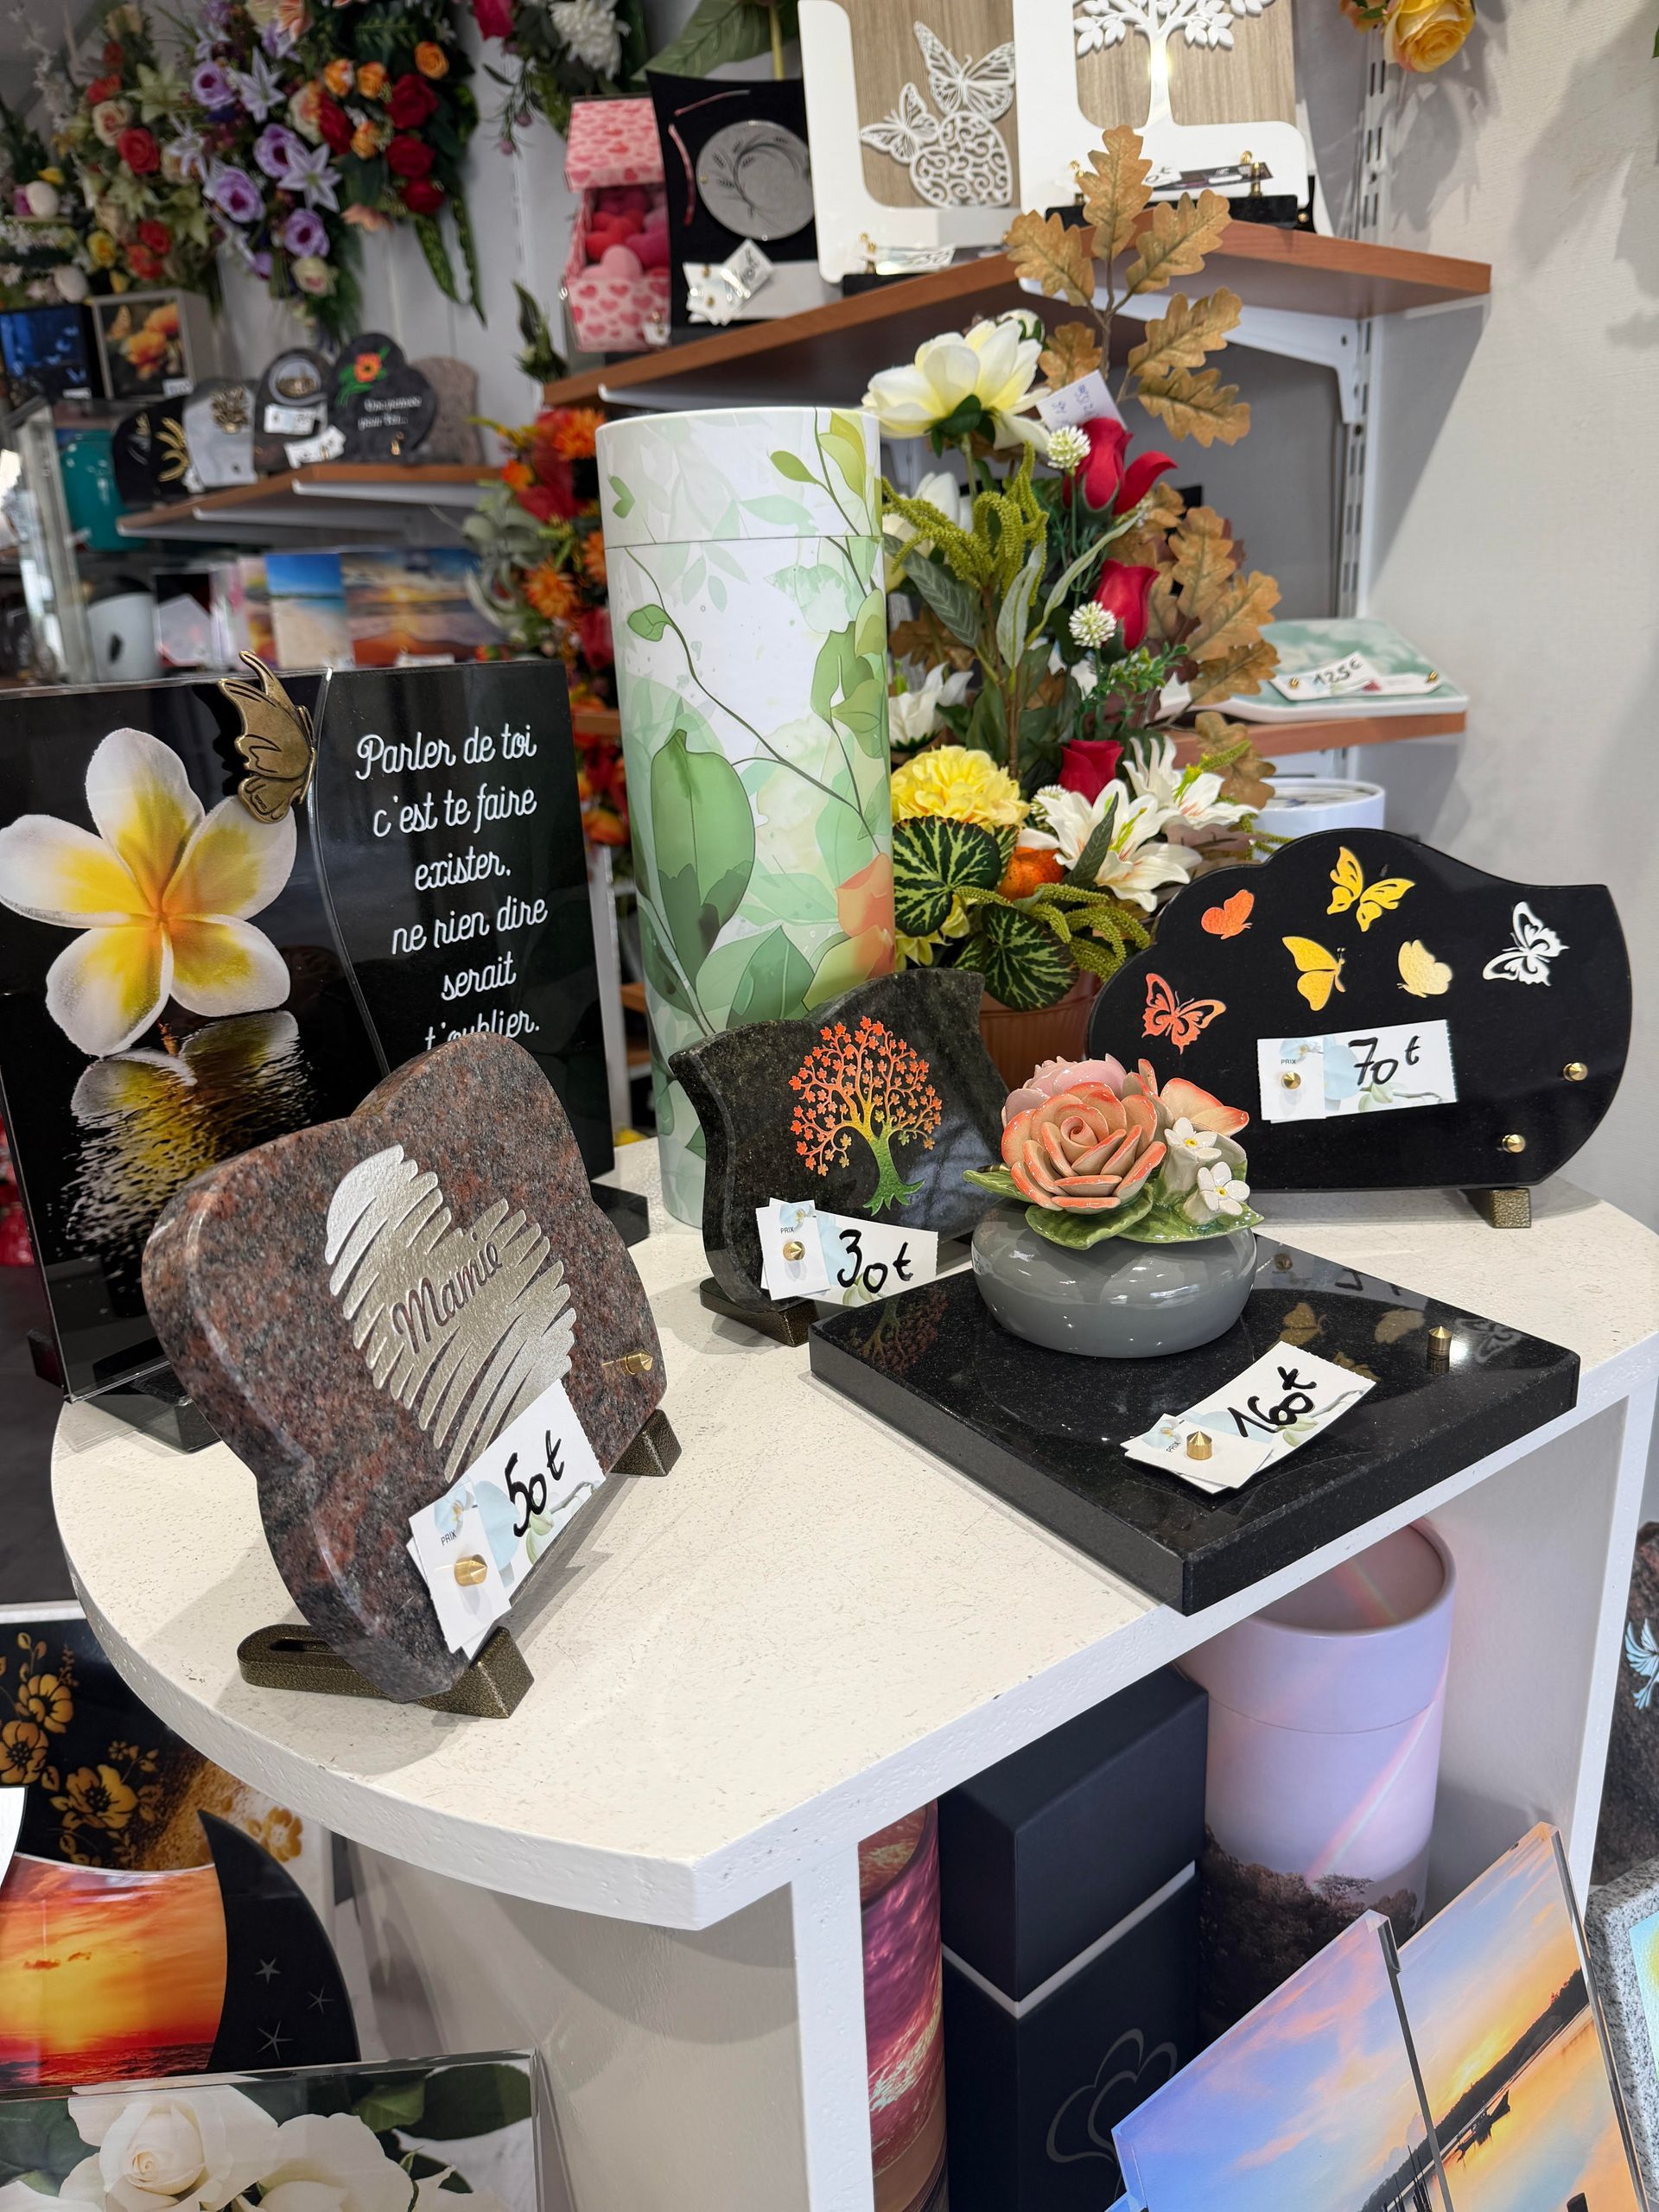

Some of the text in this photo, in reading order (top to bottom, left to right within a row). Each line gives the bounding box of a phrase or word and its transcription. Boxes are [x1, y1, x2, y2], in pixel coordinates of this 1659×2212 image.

[355, 722, 537, 780] Parler de toi
[372, 783, 537, 837] c'est te faire
[415, 845, 512, 891] exister.
[391, 895, 548, 955] ne rien dire
[441, 951, 517, 1001] serait
[391, 1232, 503, 1354] Mamie
[1166, 1440, 1181, 1453] PRIX
[441, 1529, 457, 1547] PRIX
